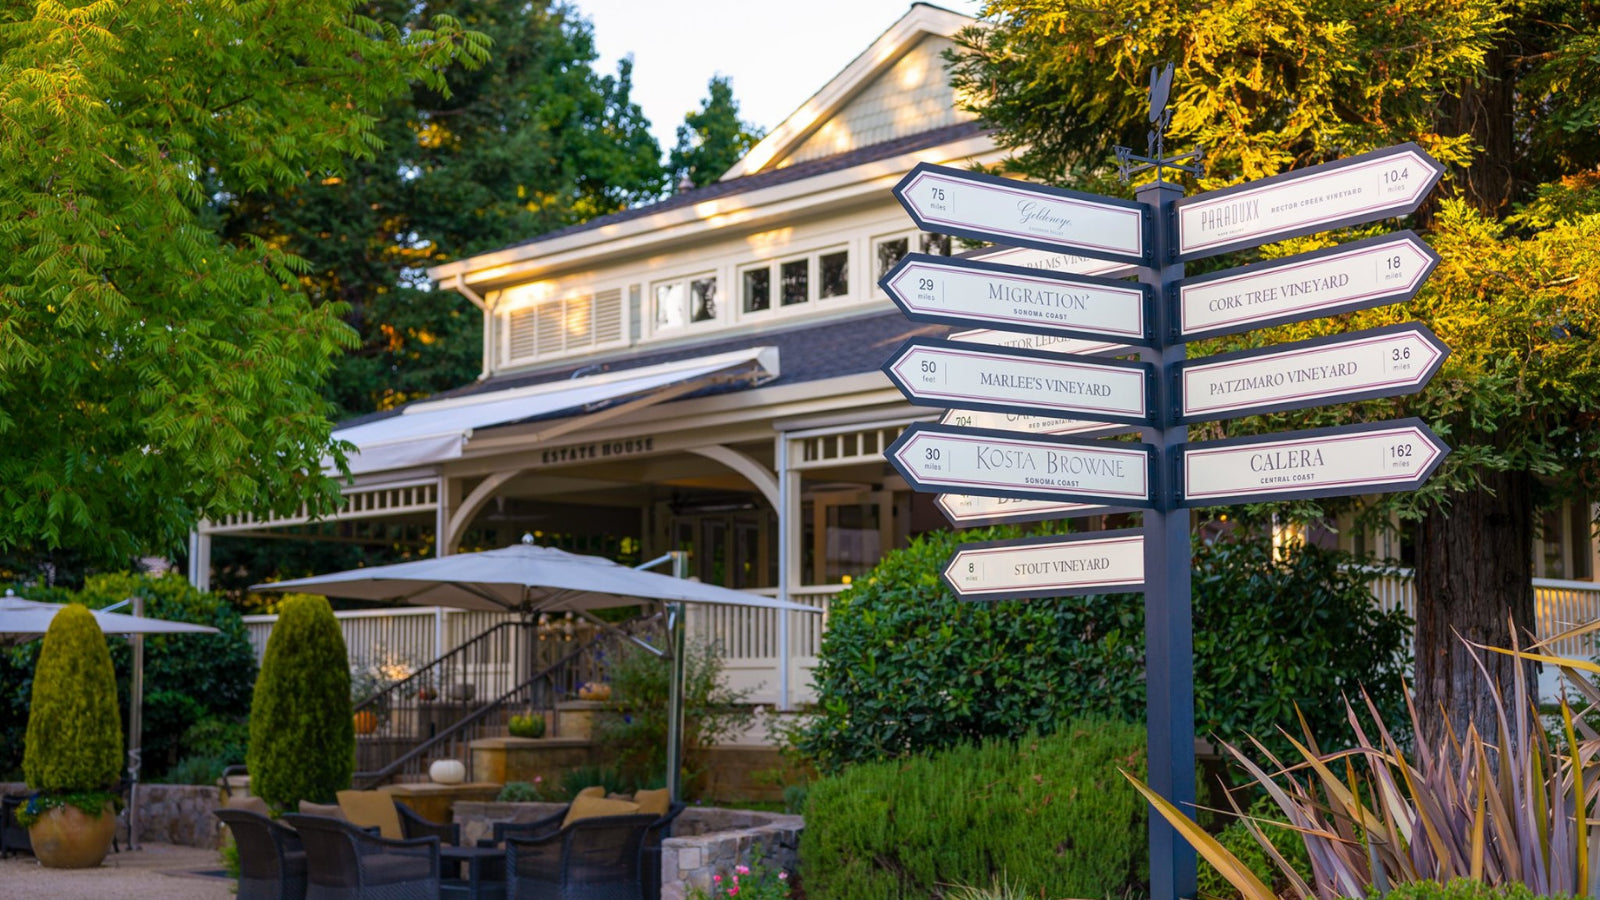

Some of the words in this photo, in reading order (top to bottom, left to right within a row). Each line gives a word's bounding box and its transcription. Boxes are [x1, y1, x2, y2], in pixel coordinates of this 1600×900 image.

[1384, 167, 1409, 184] 10.4
[931, 188, 945, 201] 75
[1387, 185, 1405, 193] miles
[1271, 203, 1298, 213] RECTOR
[1300, 197, 1324, 207] CREEK
[1326, 187, 1363, 201] VINEYARD
[930, 203, 946, 212] miles
[1201, 199, 1260, 232] PARADUXX
[1387, 256, 1400, 269] 18
[1385, 272, 1402, 281] miles
[919, 278, 934, 291] 29
[918, 293, 935, 301] miles
[1208, 294, 1243, 312] CORK
[1245, 286, 1278, 305] TREE
[1280, 273, 1349, 298] VINEYARD
[1013, 308, 1043, 317] SONOMA
[1045, 312, 1068, 320] COAST
[1392, 347, 1410, 361] 3.6
[921, 360, 936, 373] 50
[1392, 363, 1411, 371] miles
[922, 375, 935, 383] feet
[980, 372, 1043, 390] MARLEE'S
[1045, 379, 1111, 397] VINEYARD
[1210, 372, 1284, 396] PATZIMARO
[1287, 361, 1358, 384] VINEYARD
[542, 445, 596, 464] ESTATE
[602, 438, 654, 456] HOUSE
[925, 448, 940, 460] 30
[1390, 444, 1412, 458] 162
[924, 463, 941, 471] miles
[976, 445, 1036, 471] KOSTA
[1047, 451, 1125, 478] BROWNE
[1250, 448, 1325, 473] CALERA
[1392, 460, 1410, 468] miles
[1025, 477, 1055, 486] SONOMA
[1057, 479, 1080, 487] COAST
[1260, 474, 1291, 484] CENTRAL
[1293, 473, 1315, 482] COAST
[968, 563, 975, 573] 8
[1014, 562, 1051, 576] STOUT
[1053, 557, 1110, 573] VINEYARD
